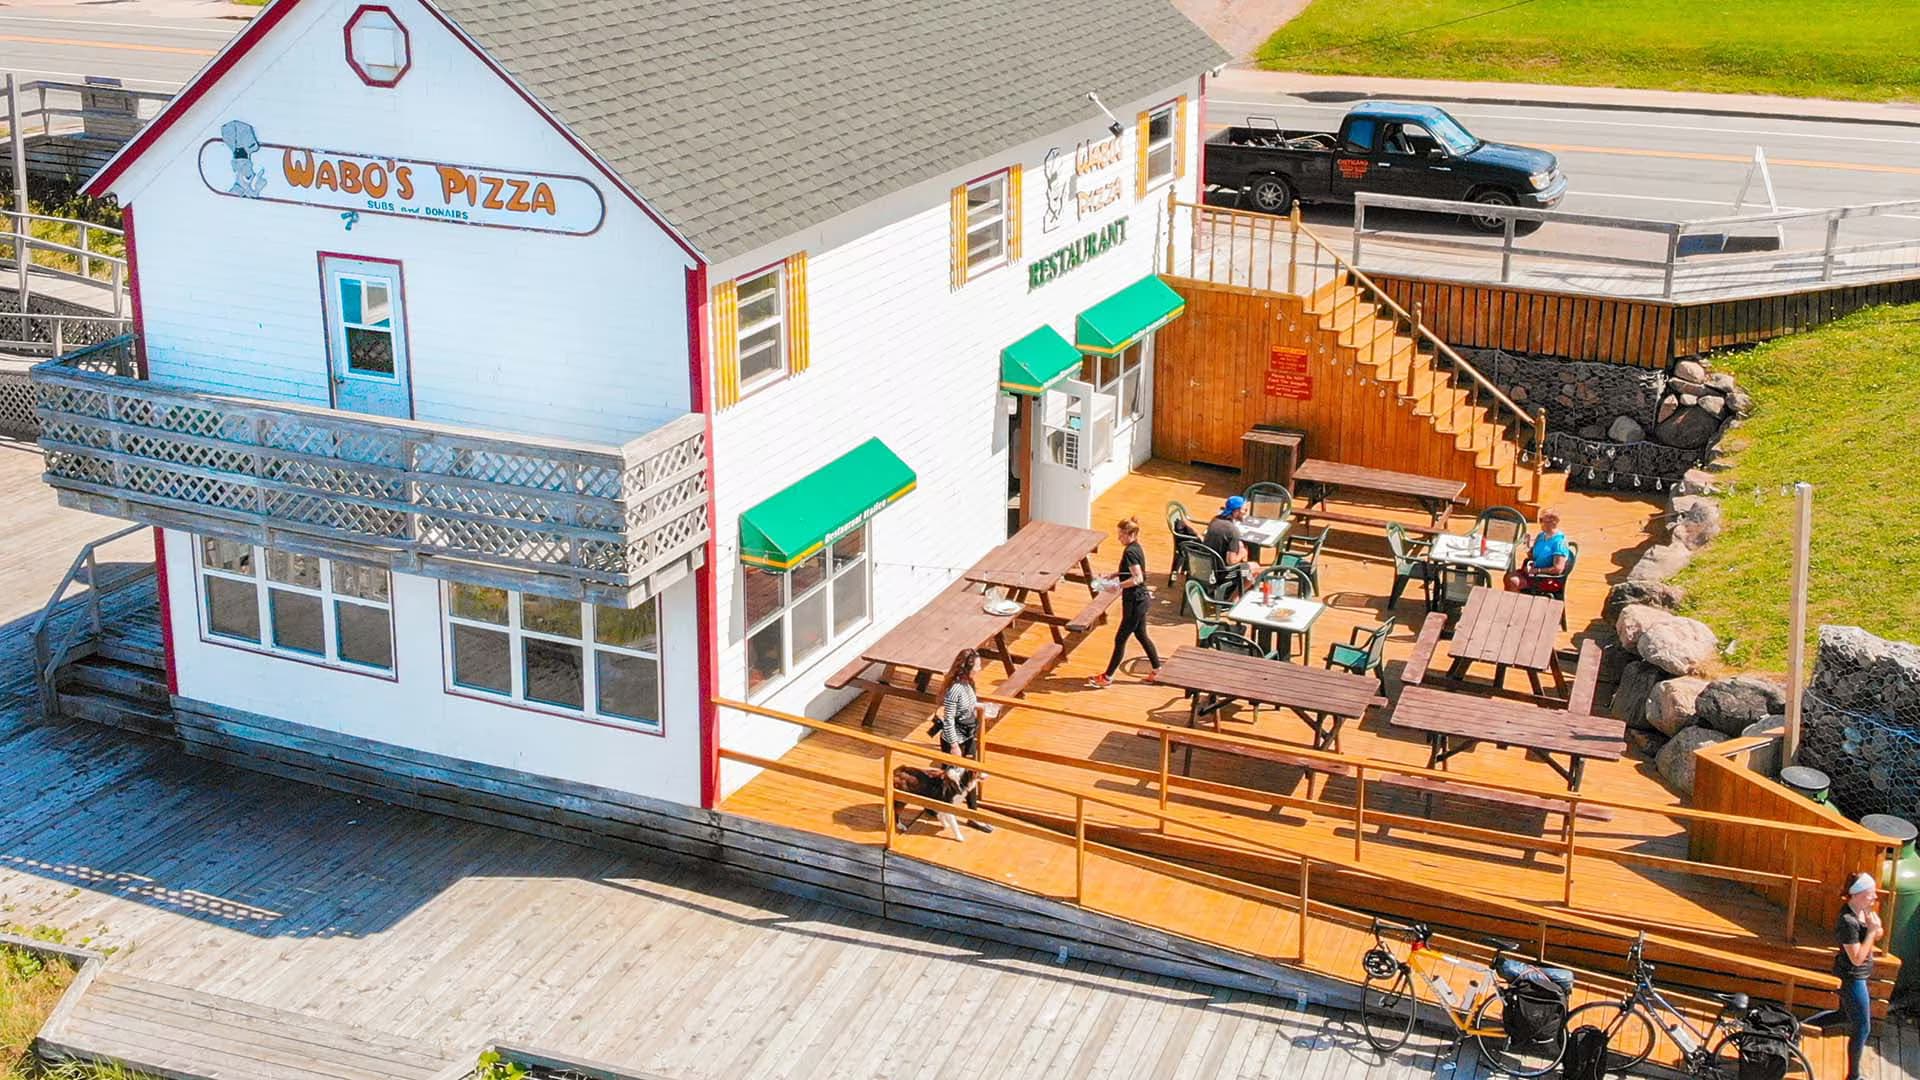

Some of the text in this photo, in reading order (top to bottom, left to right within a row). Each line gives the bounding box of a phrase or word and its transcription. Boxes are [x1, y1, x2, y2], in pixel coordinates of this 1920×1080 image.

[282, 147, 556, 215] WABO'S PIZZA
[367, 200, 469, 220] SUBS and DONAIRS
[1027, 215, 1129, 294] RESTAURANT
